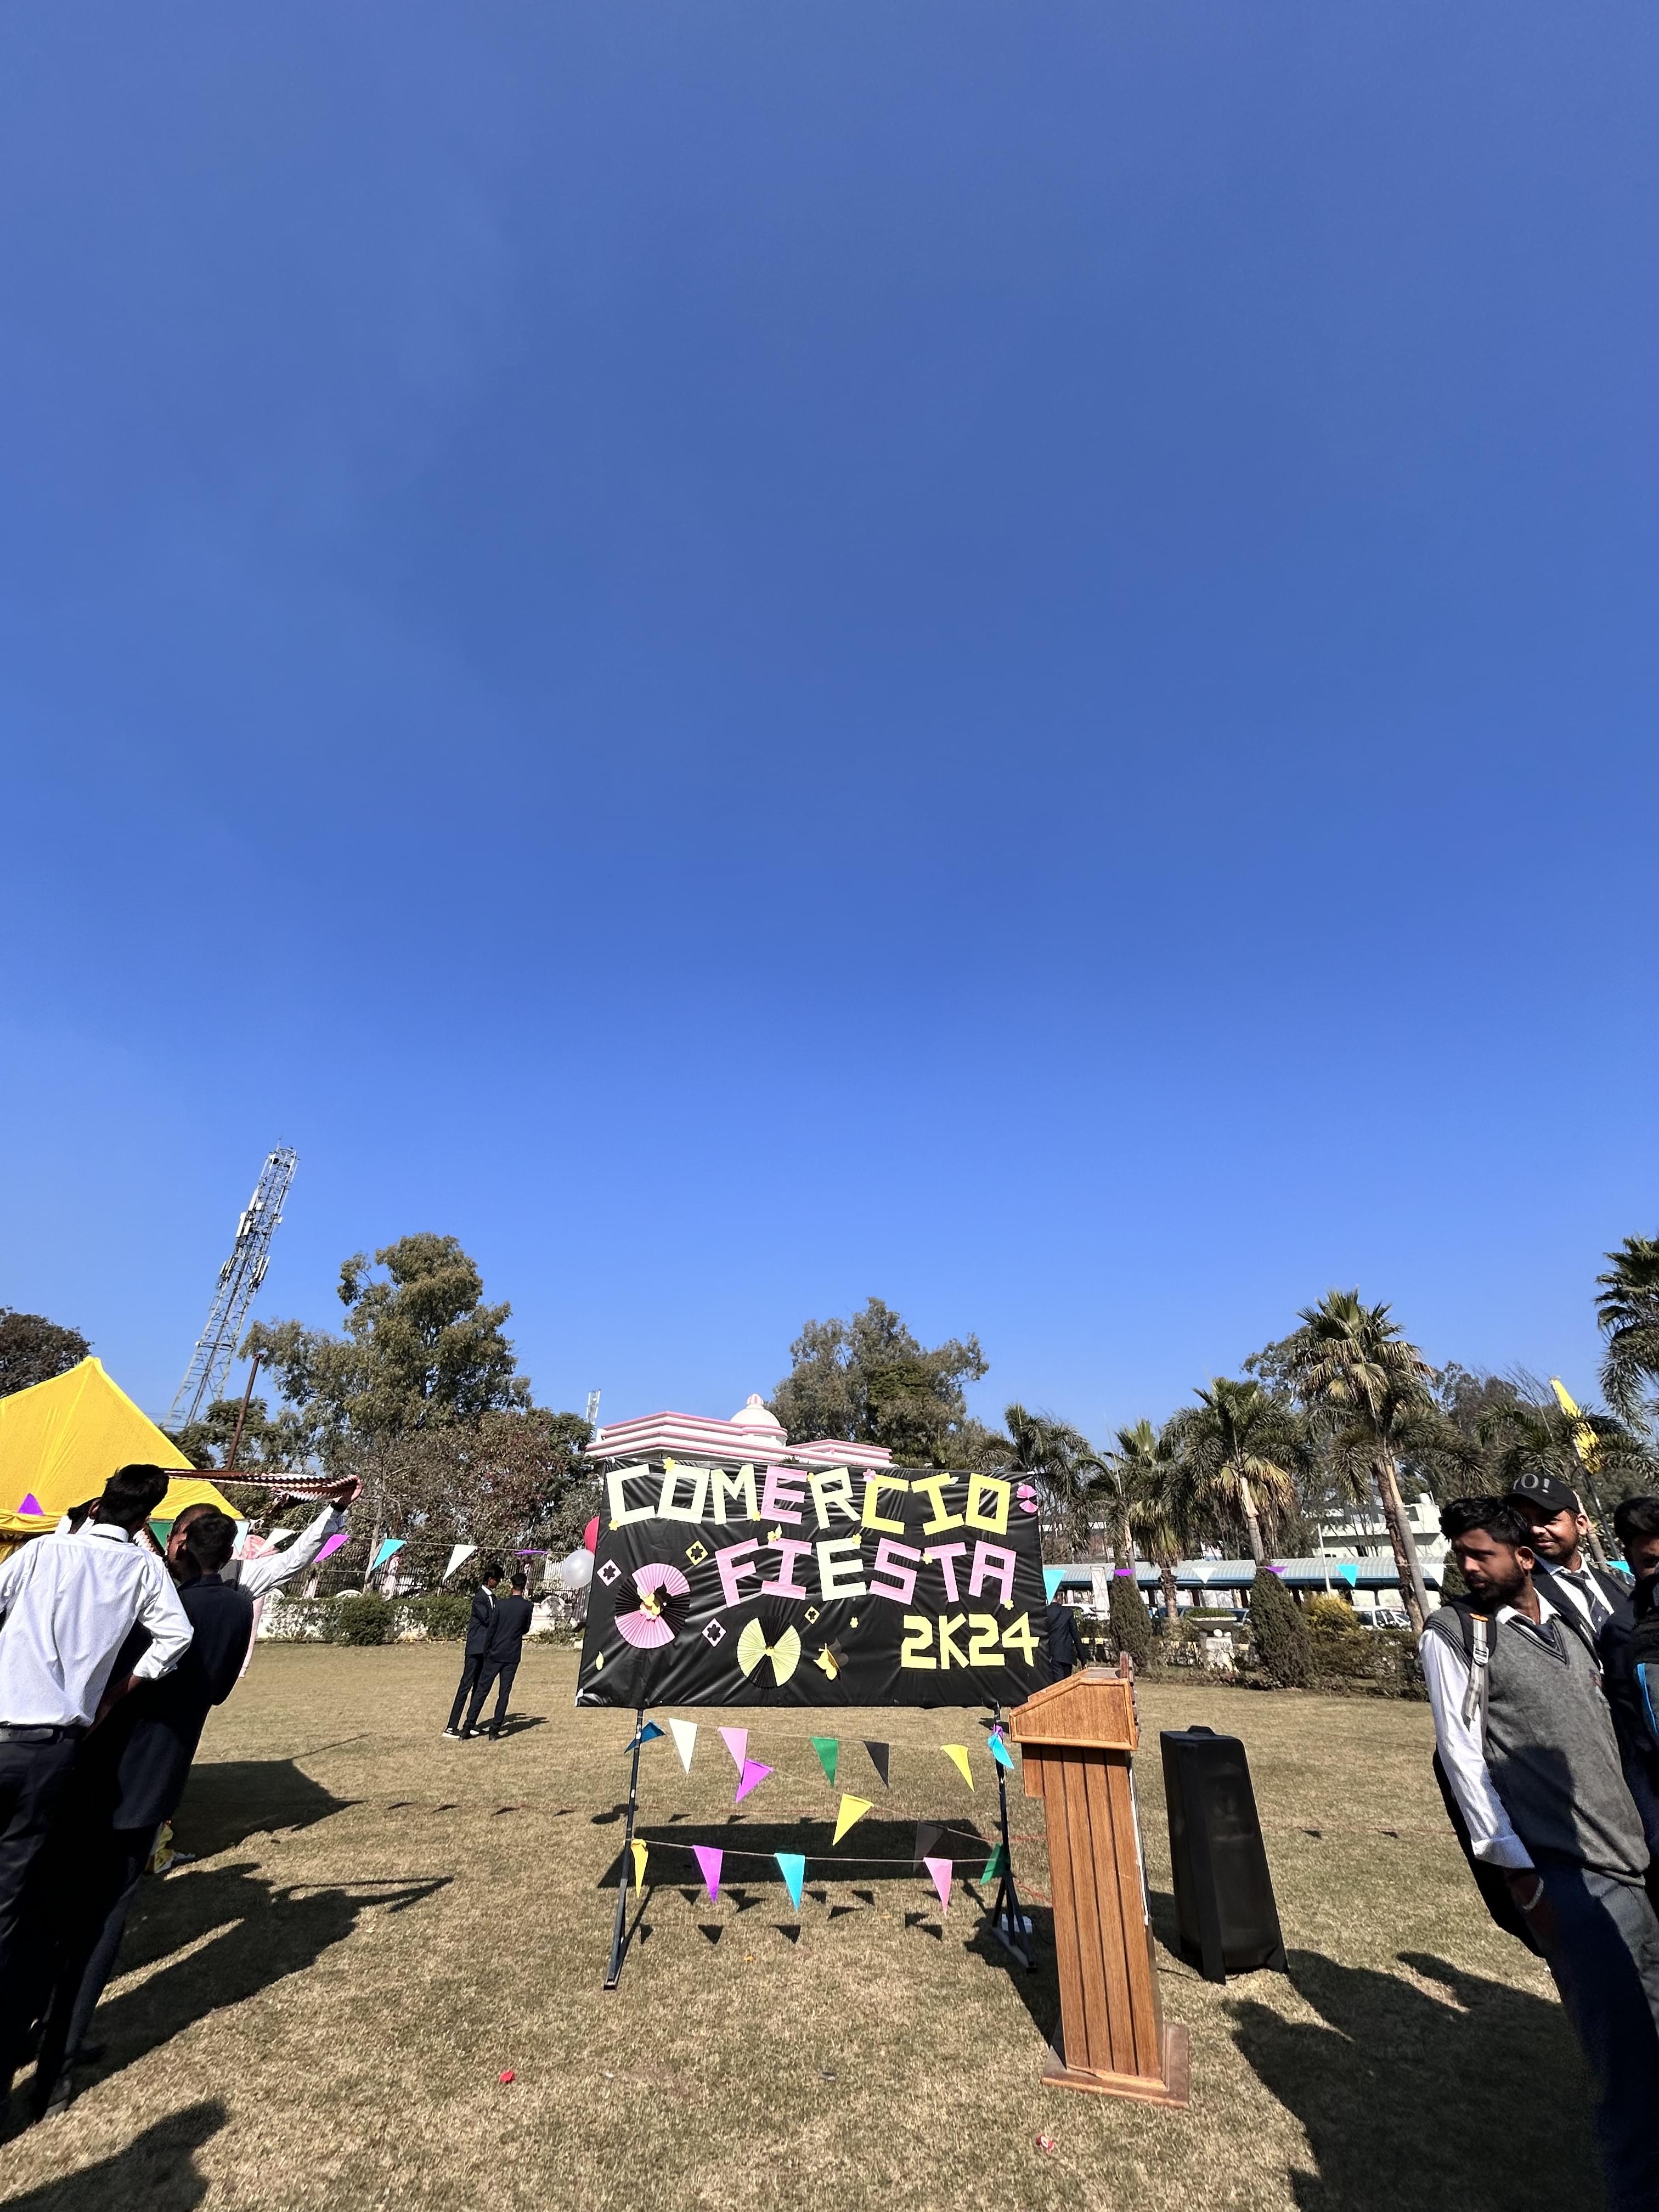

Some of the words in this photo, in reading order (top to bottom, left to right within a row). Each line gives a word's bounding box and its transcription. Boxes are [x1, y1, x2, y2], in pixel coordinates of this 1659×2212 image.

[606, 1463, 1011, 1536] COMERCIO
[715, 1537, 1017, 1608] FIESTA
[901, 1612, 1040, 1670] 2K24
